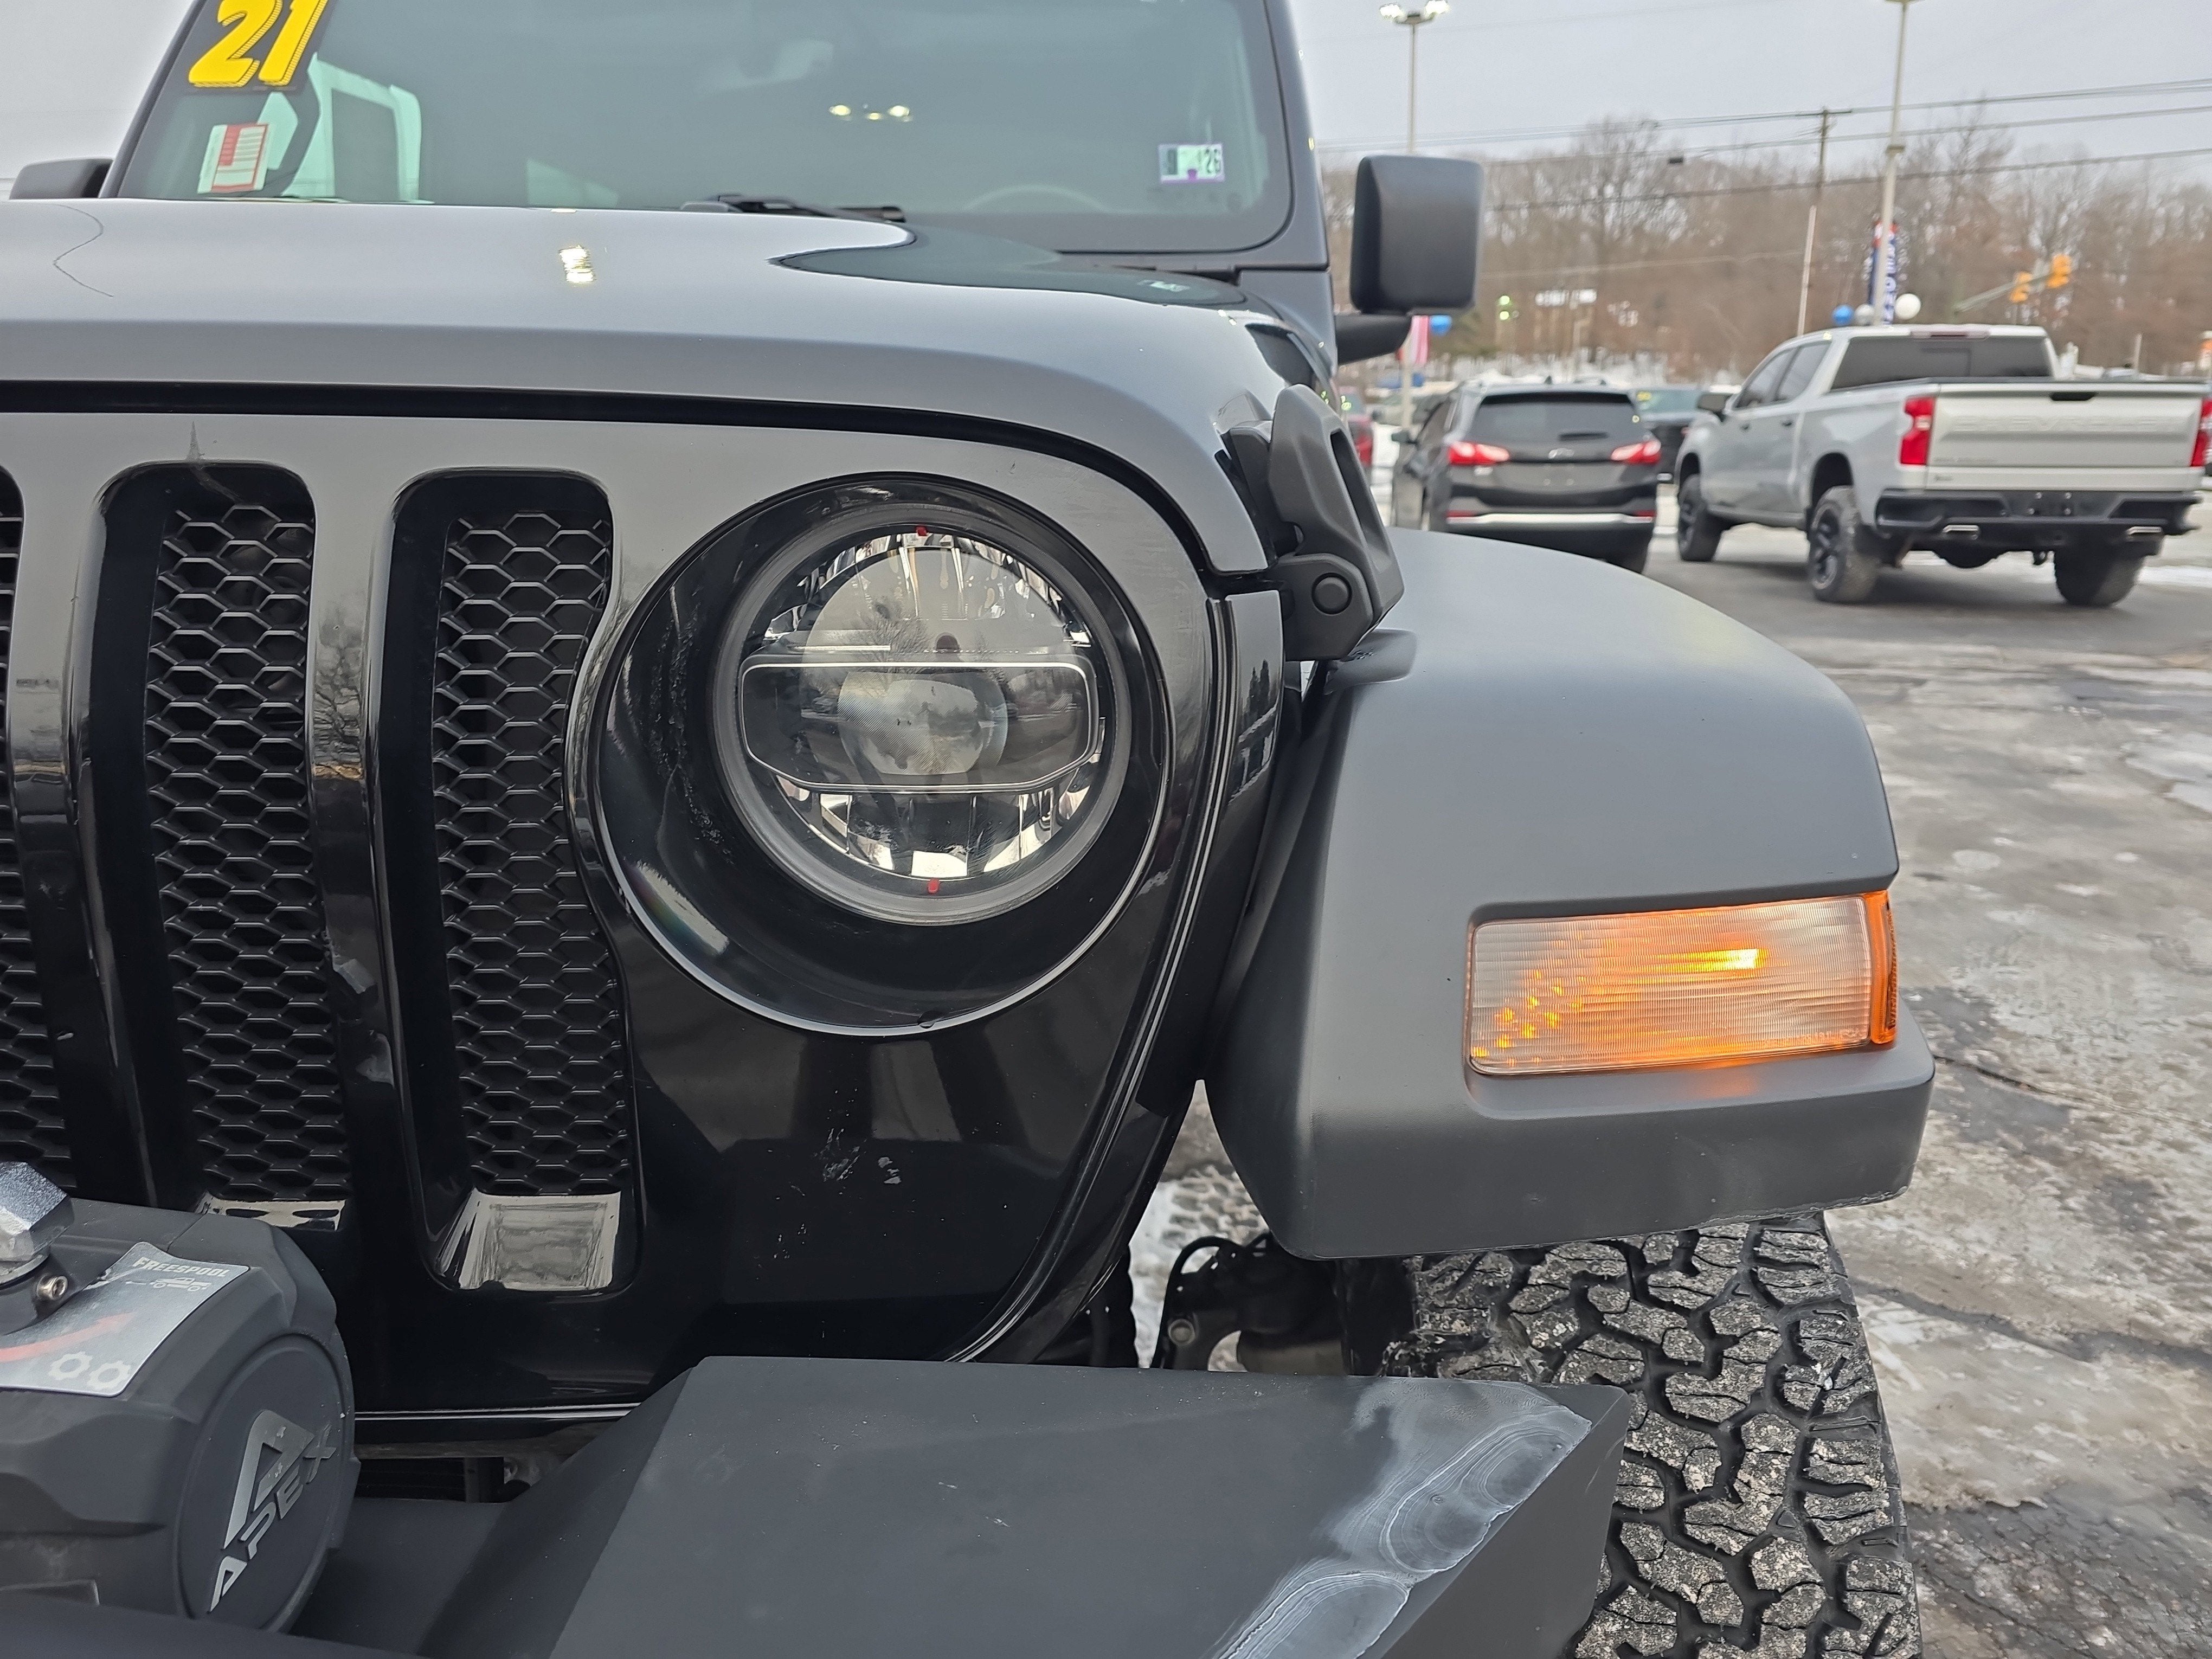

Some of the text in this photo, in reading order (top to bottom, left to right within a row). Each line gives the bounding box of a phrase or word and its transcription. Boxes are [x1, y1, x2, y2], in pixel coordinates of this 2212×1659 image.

[188, 0, 326, 88] 21
[132, 1256, 230, 1277] FREESPOOL
[209, 1423, 337, 1612] APEX
